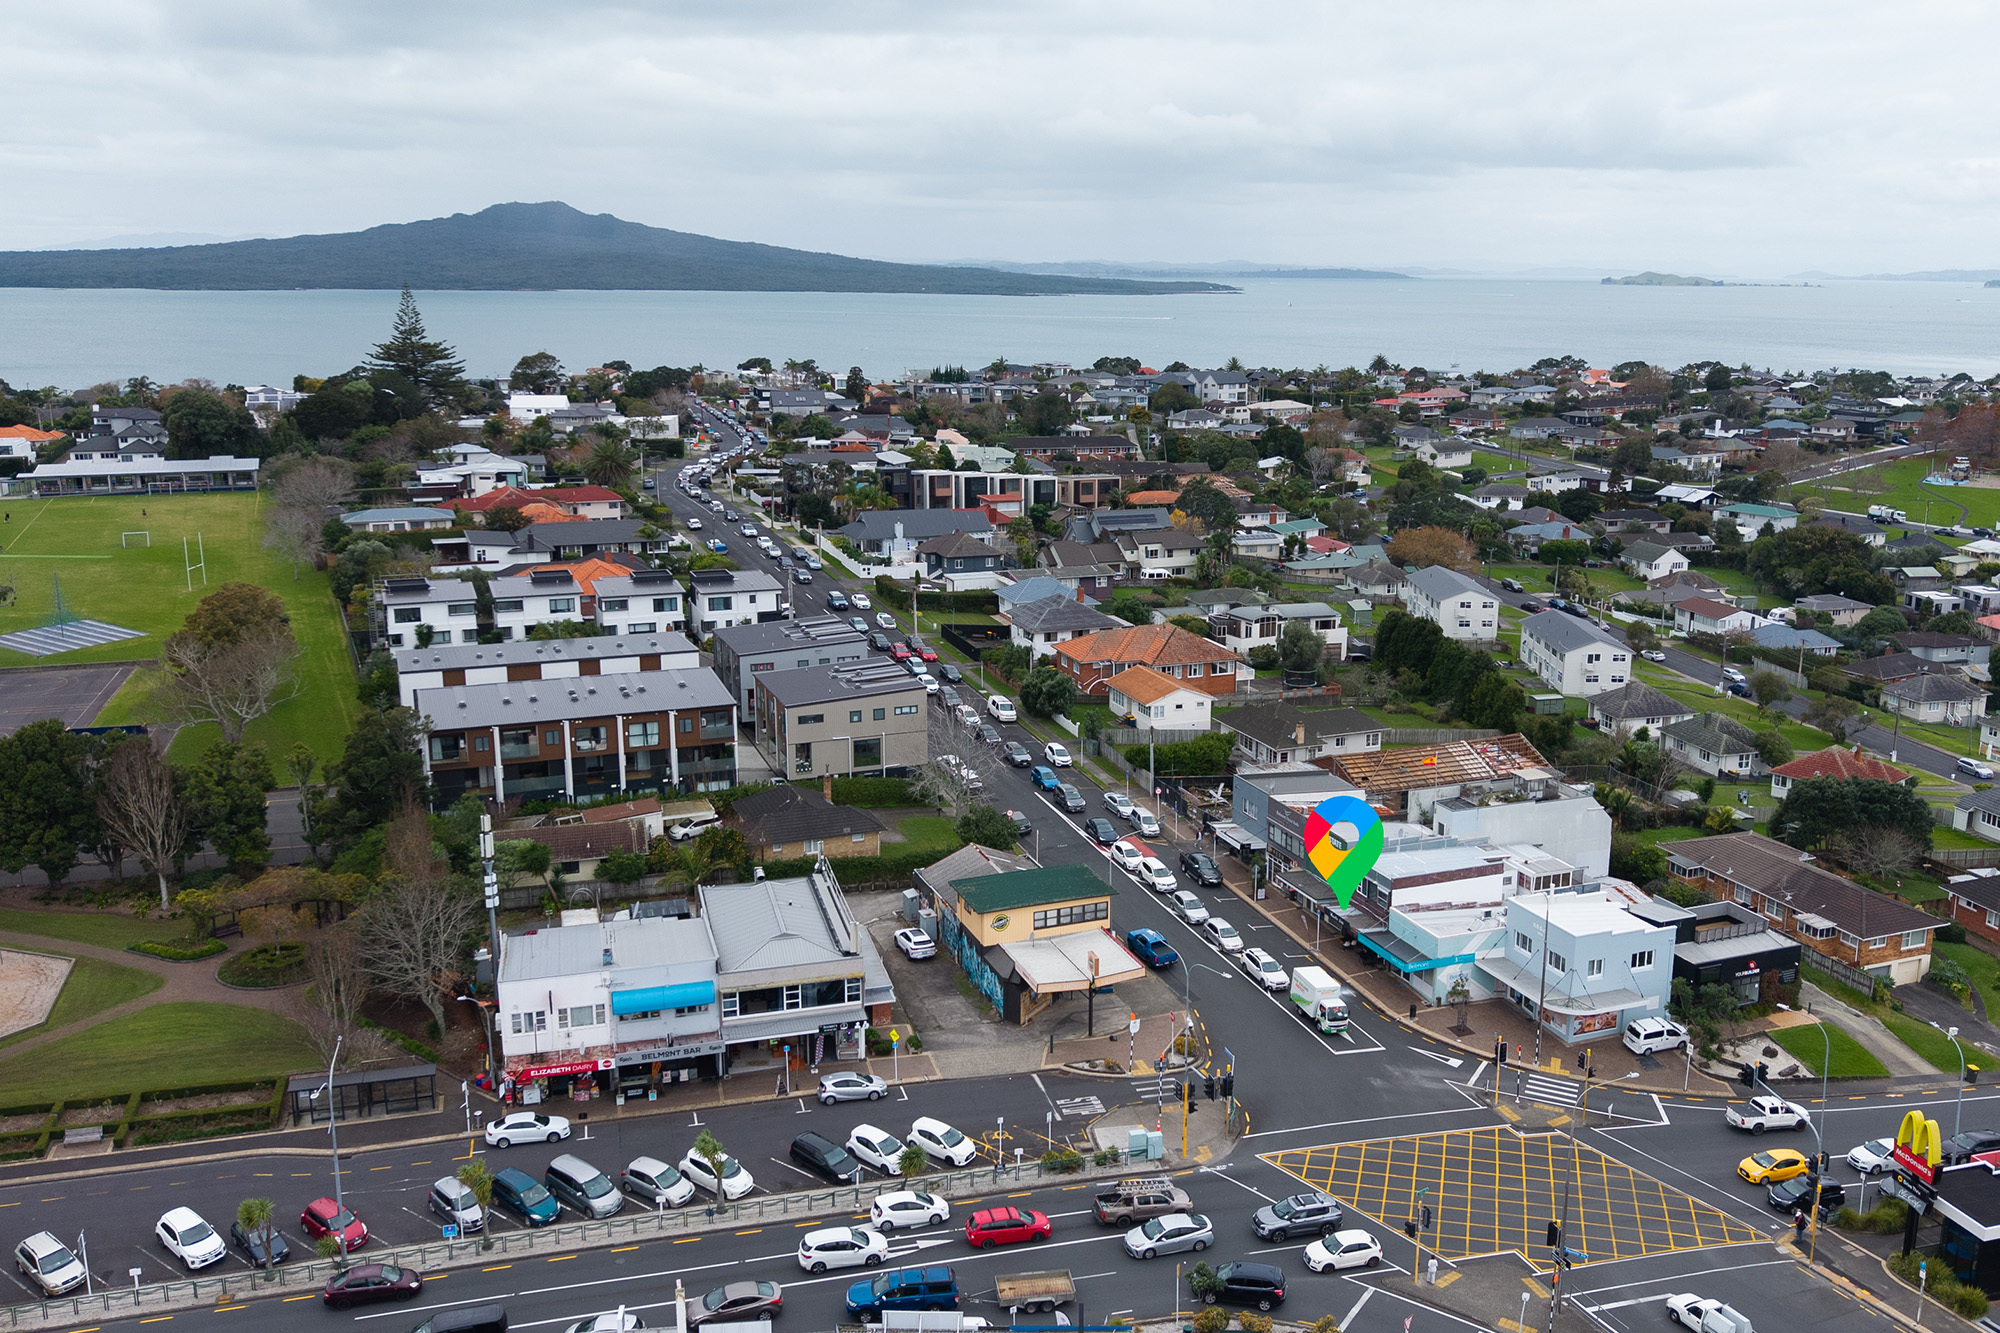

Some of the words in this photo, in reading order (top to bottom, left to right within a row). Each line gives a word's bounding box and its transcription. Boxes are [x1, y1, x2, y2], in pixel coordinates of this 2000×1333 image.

[641, 1049, 682, 1061] BELMONT
[683, 1046, 702, 1055] BAR
[530, 1066, 572, 1077] ELIZABETH
[572, 1063, 594, 1072] DAIRY
[1896, 1148, 1931, 1176] McDonald's
